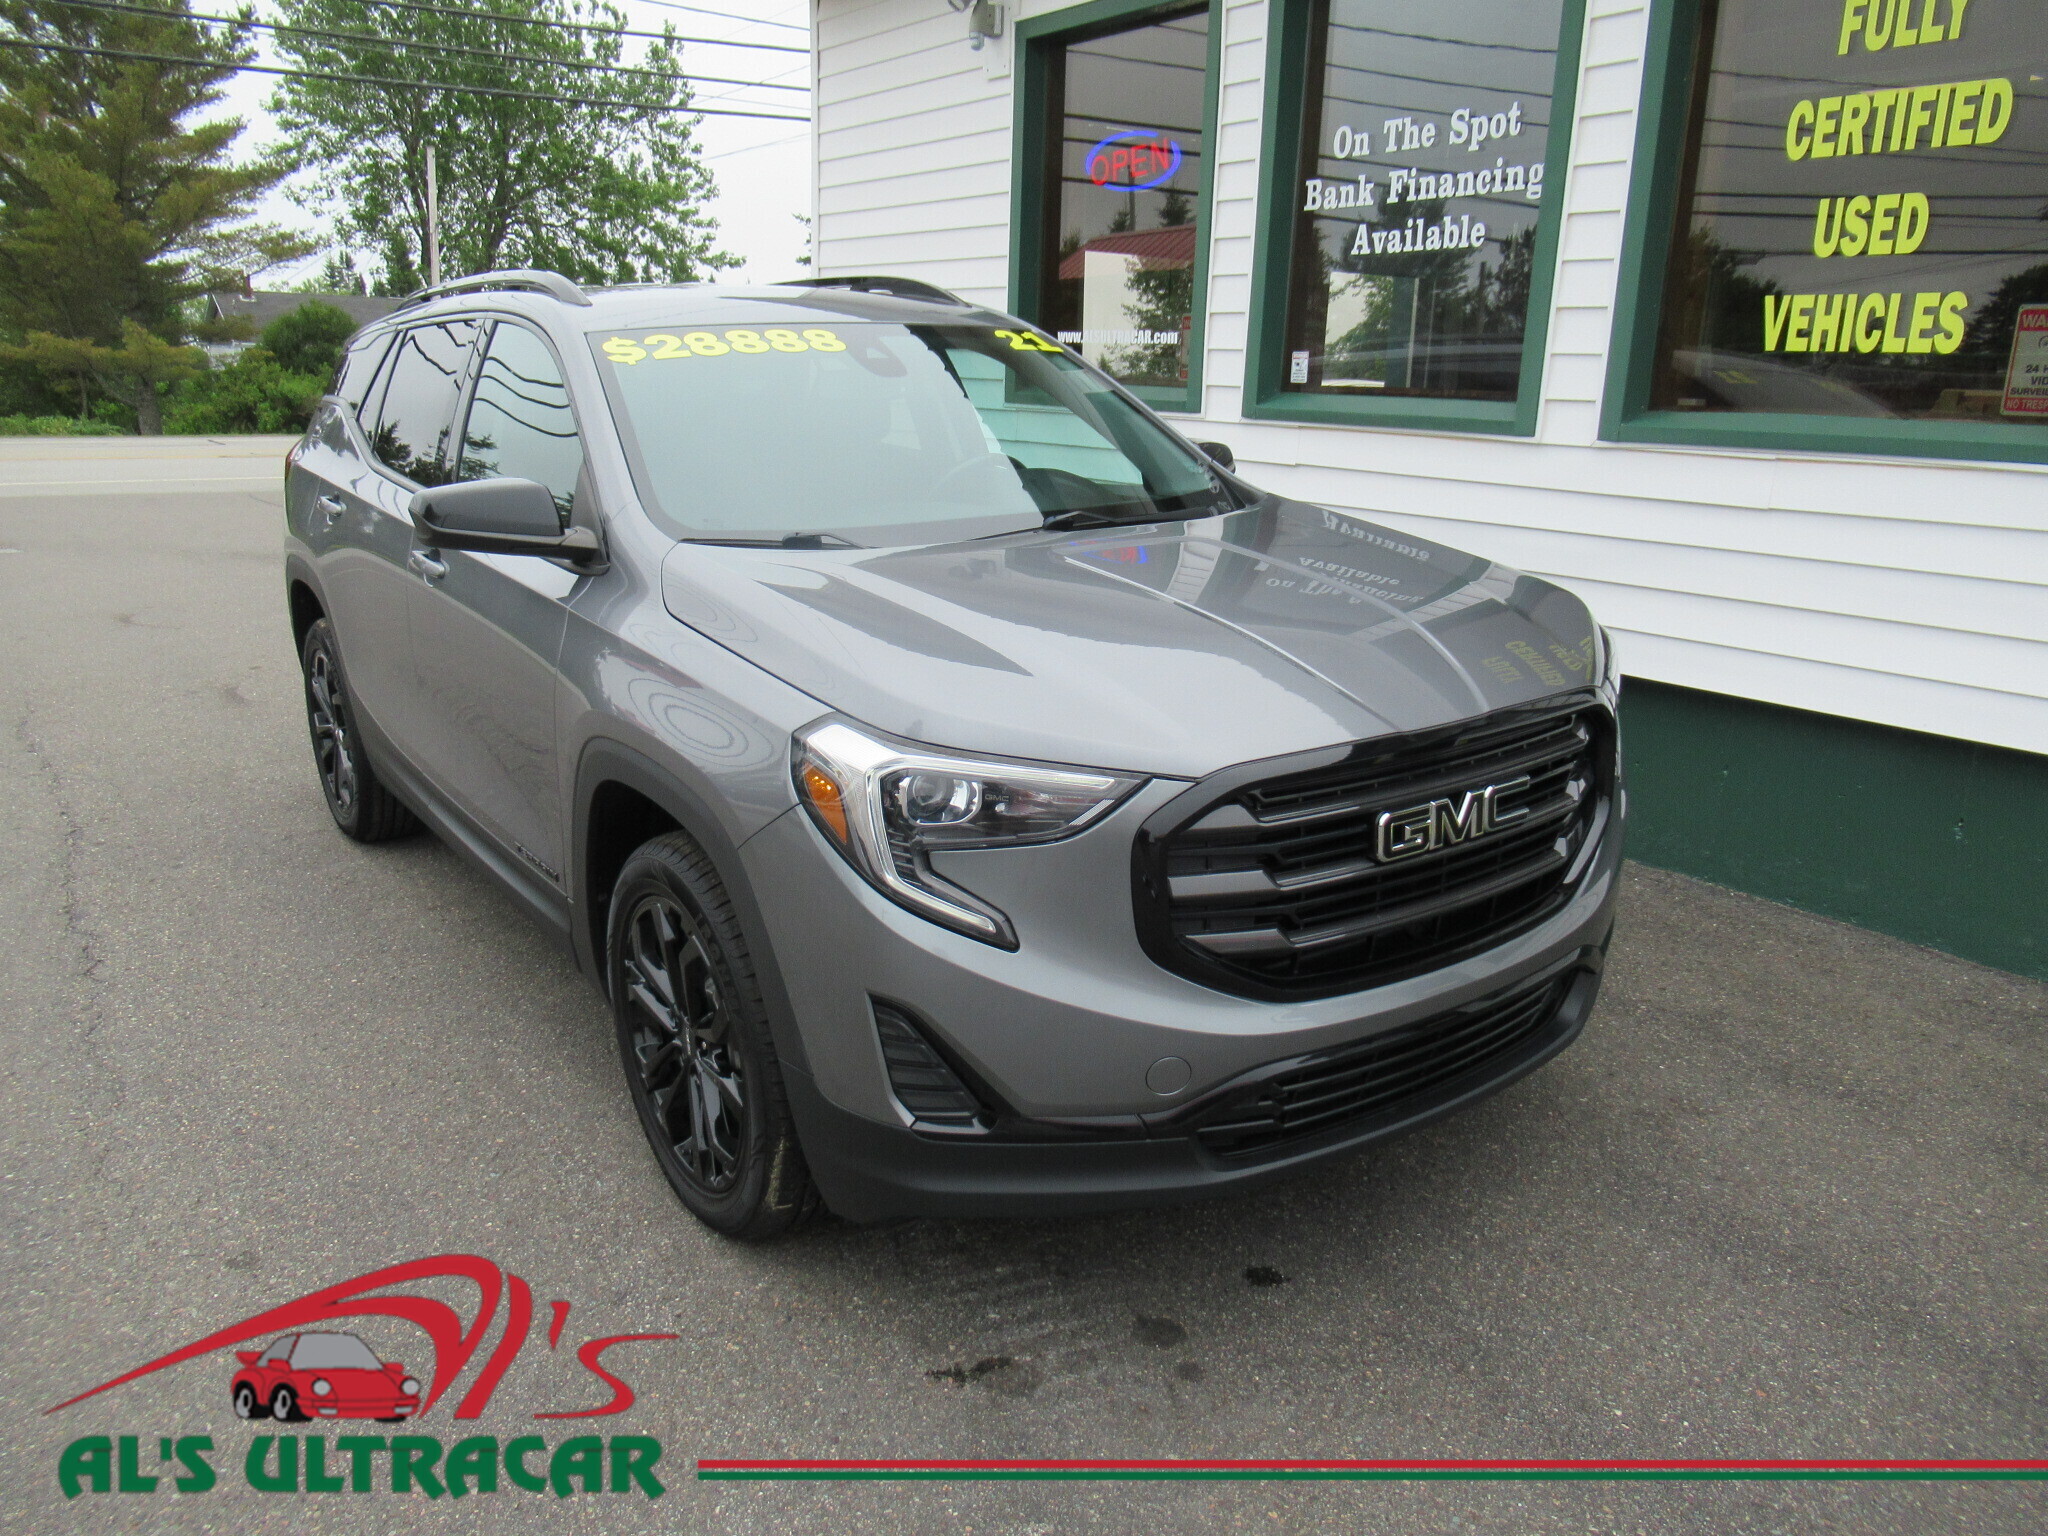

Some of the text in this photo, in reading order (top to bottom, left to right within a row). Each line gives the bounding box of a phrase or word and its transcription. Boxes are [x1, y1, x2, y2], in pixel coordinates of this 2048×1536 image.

[1837, 0, 1969, 56] FULLY
[1333, 101, 1522, 158] On The Spot
[1785, 78, 2014, 162] CERTIFIED
[1090, 137, 1170, 187] OPEN
[1303, 157, 1545, 211] Bank Financing
[1350, 215, 1486, 255] Available
[1813, 192, 1930, 259] USED
[602, 329, 847, 365] $28888
[994, 329, 1064, 353] 21
[1764, 290, 1969, 355] VEHICLES
[2006, 399, 2020, 409] NO
[984, 793, 1009, 802] GMC
[1377, 775, 1530, 863] GMC
